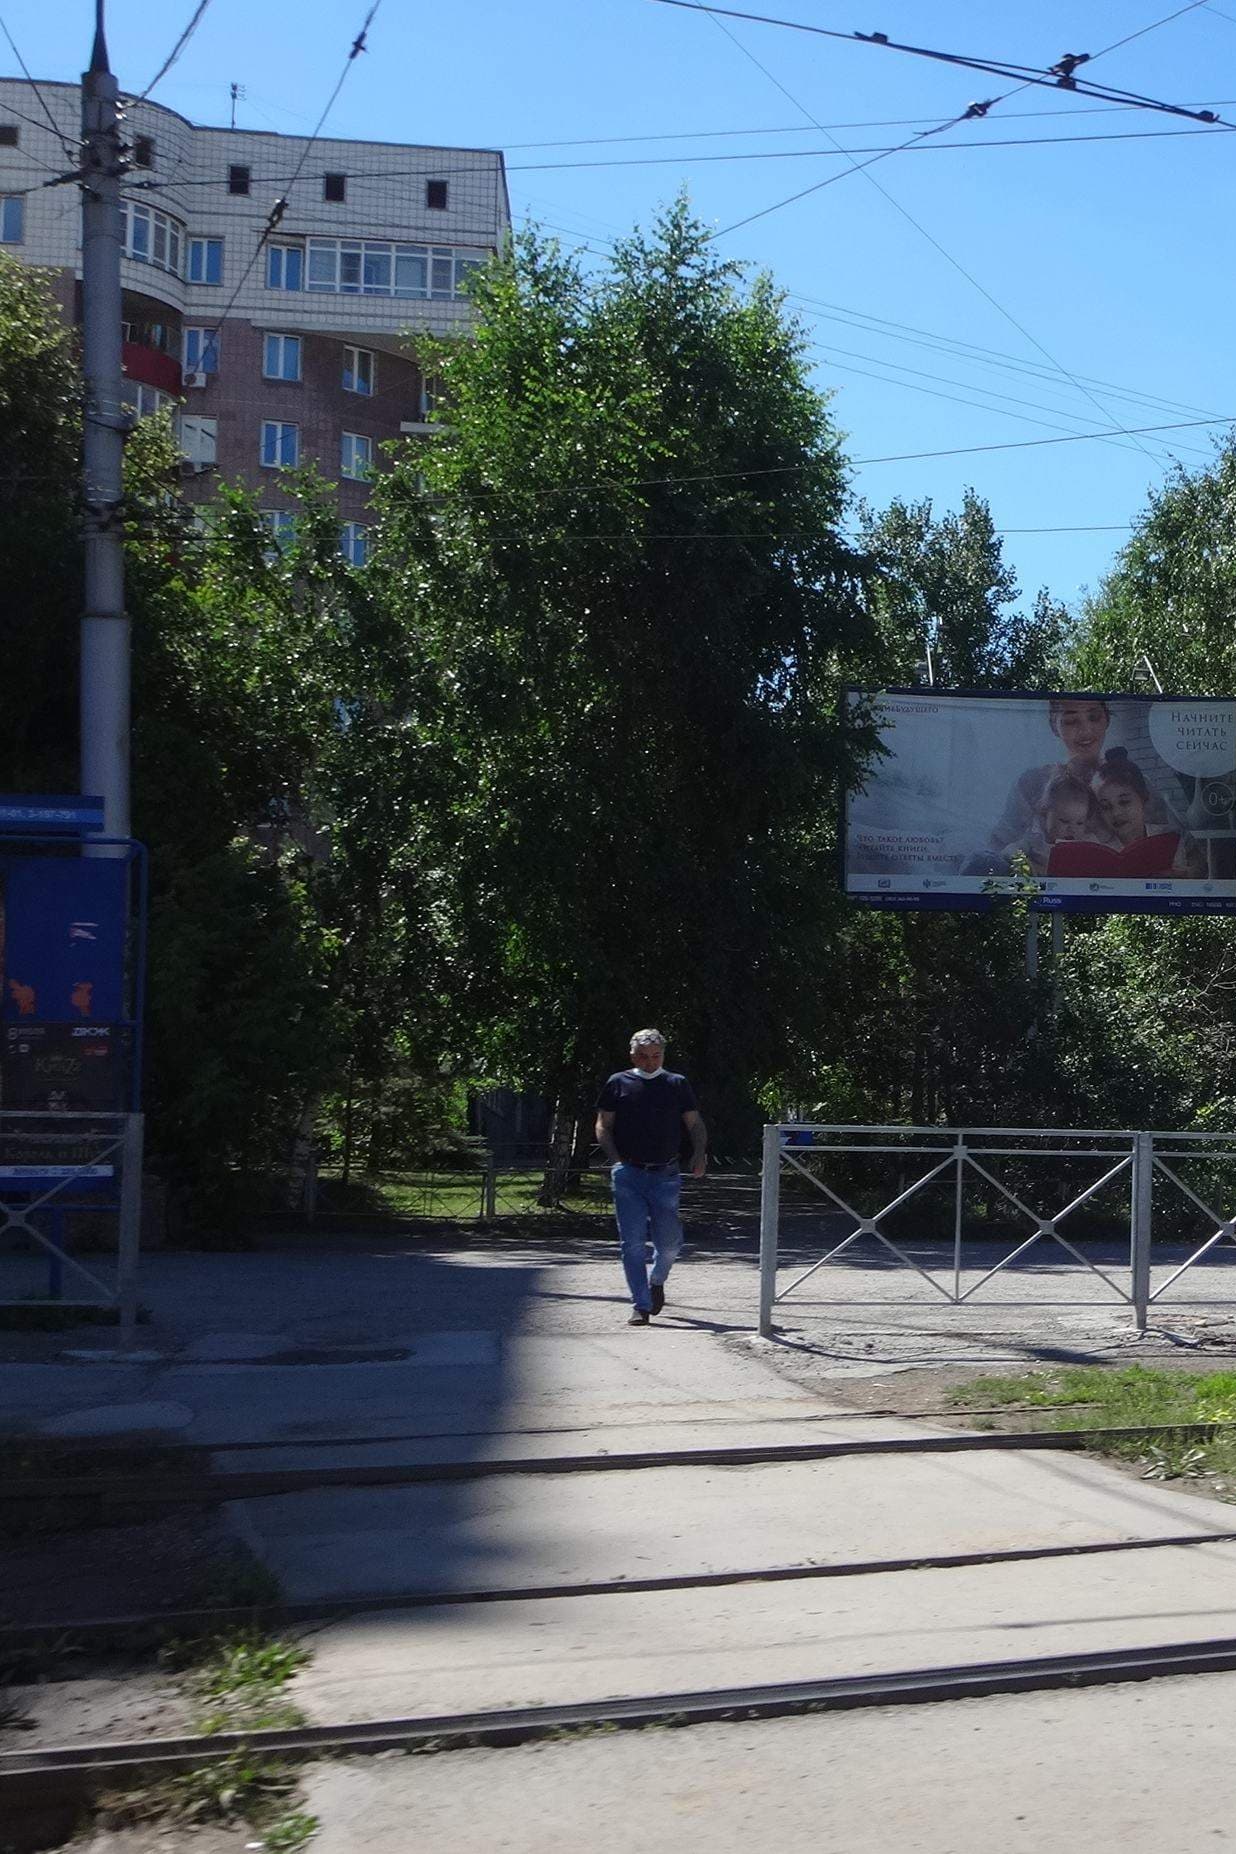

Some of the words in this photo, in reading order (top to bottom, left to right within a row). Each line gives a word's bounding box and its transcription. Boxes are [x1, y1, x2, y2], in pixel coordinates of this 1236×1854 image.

[1176, 727, 1228, 737] ЧИТАТЬ
[1176, 740, 1229, 751] СЕЙЧАС
[1208, 791, 1225, 806] 0+
[877, 835, 903, 844] ТАКОЕ
